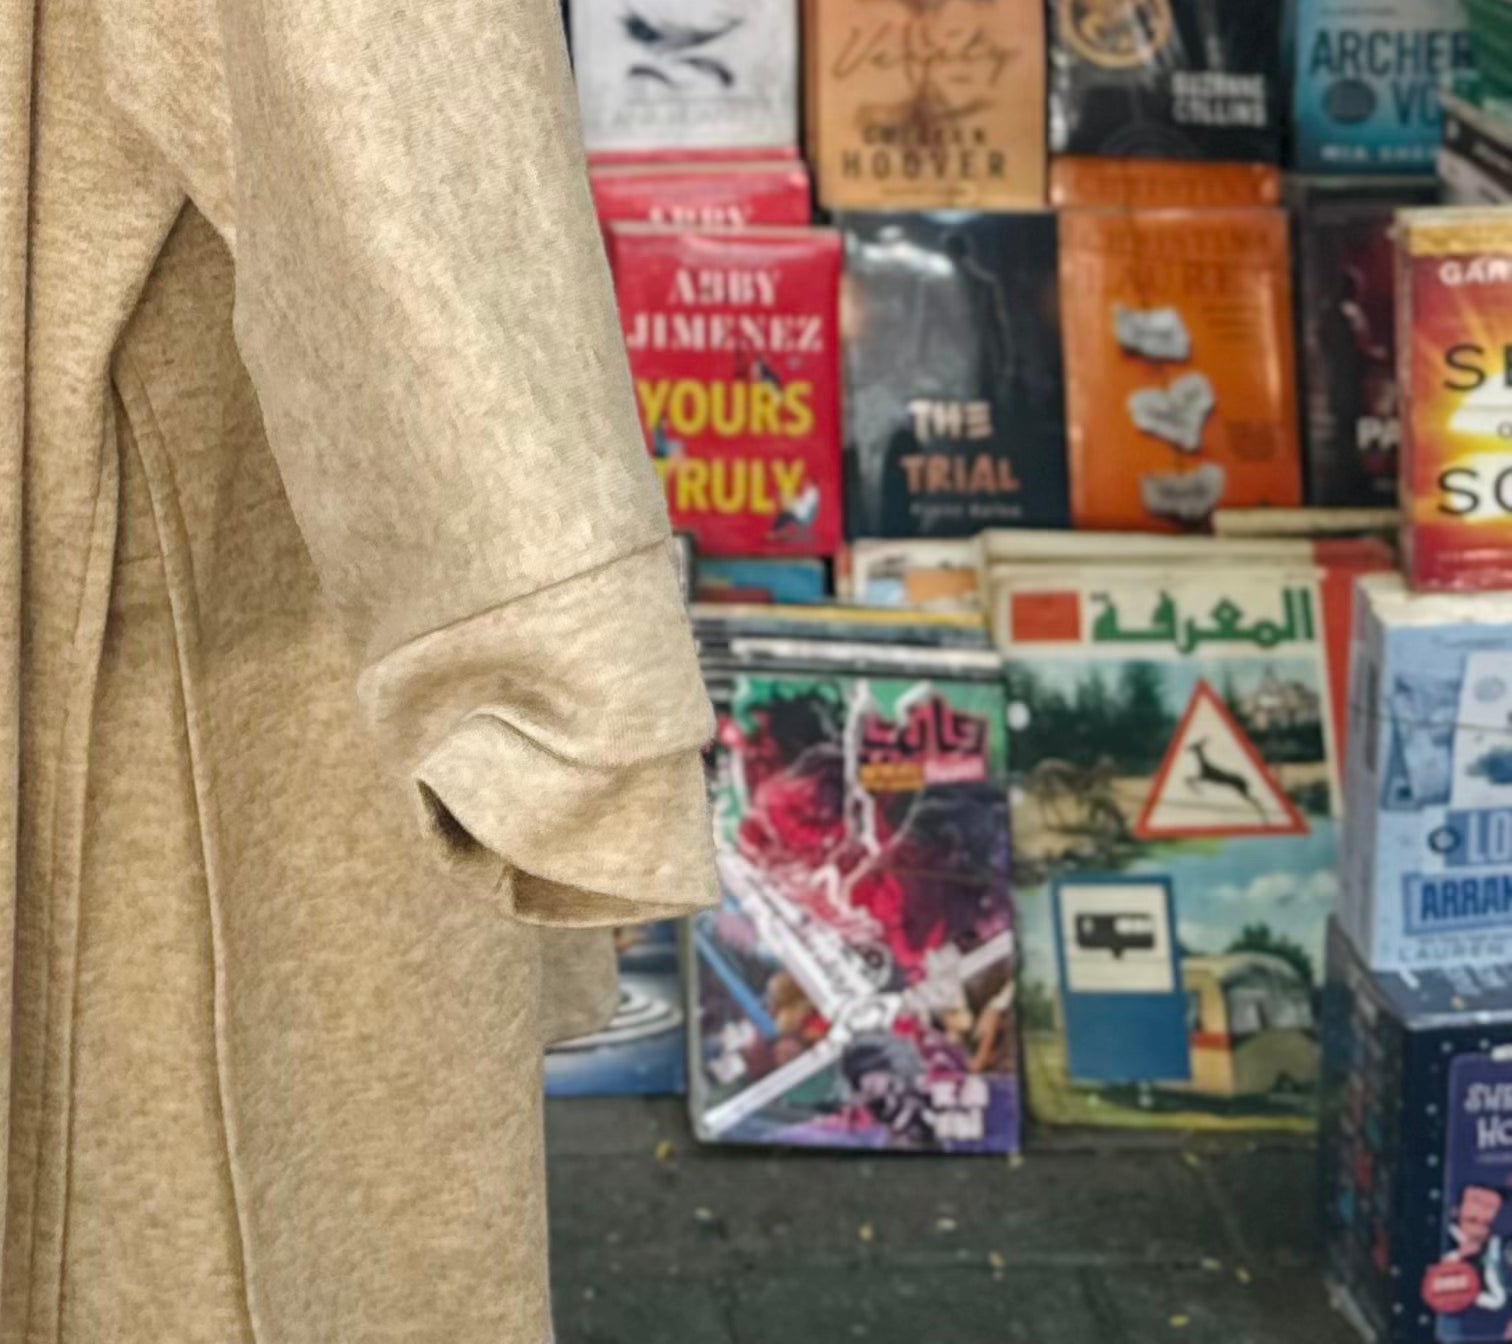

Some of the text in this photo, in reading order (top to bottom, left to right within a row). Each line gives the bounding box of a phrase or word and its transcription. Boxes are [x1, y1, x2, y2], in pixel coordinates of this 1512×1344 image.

[840, 149, 1008, 180] HOOVER
[667, 267, 782, 307] ABBY
[626, 312, 824, 352] JIMENEZ
[637, 378, 816, 437] YOURS
[907, 398, 995, 441] THE
[653, 458, 806, 516] TRULY
[901, 454, 1020, 494] TRIAL
[1089, 586, 1316, 655] المعرفة
